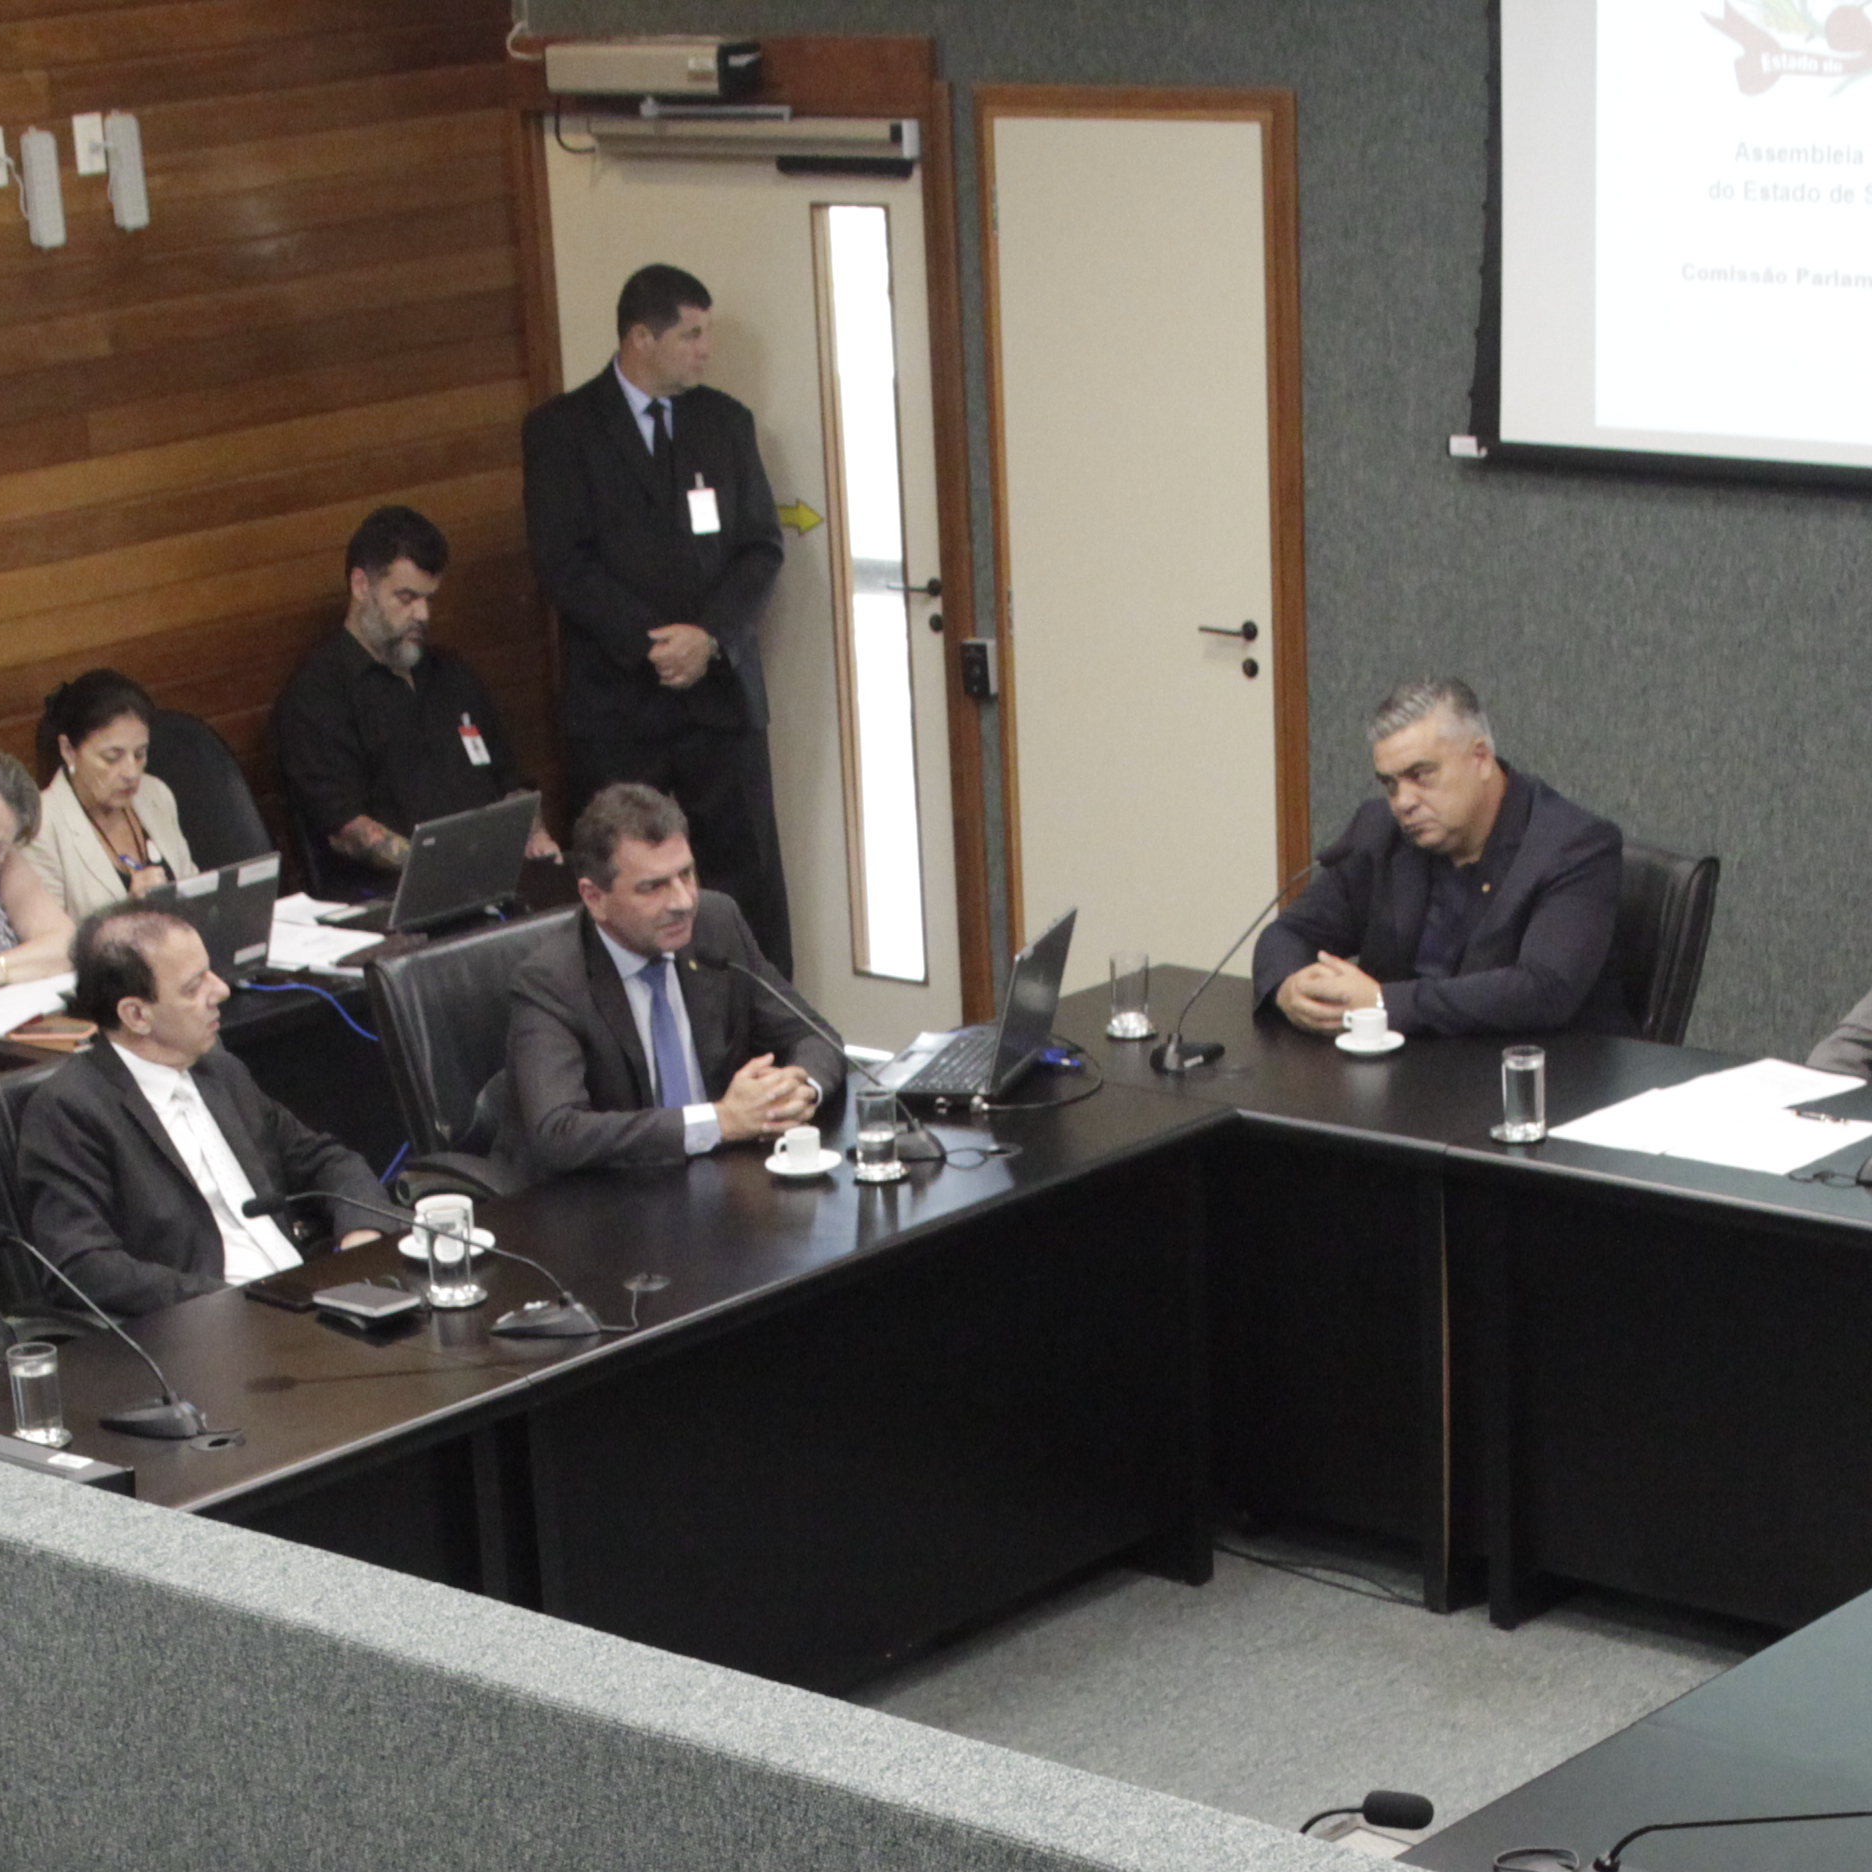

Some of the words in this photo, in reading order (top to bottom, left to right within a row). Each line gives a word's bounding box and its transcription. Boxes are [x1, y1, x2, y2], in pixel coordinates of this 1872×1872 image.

[1734, 140, 1864, 166] Assembleia
[1707, 179, 1735, 201] do
[1743, 180, 1821, 203] Estado
[1829, 182, 1855, 205] de
